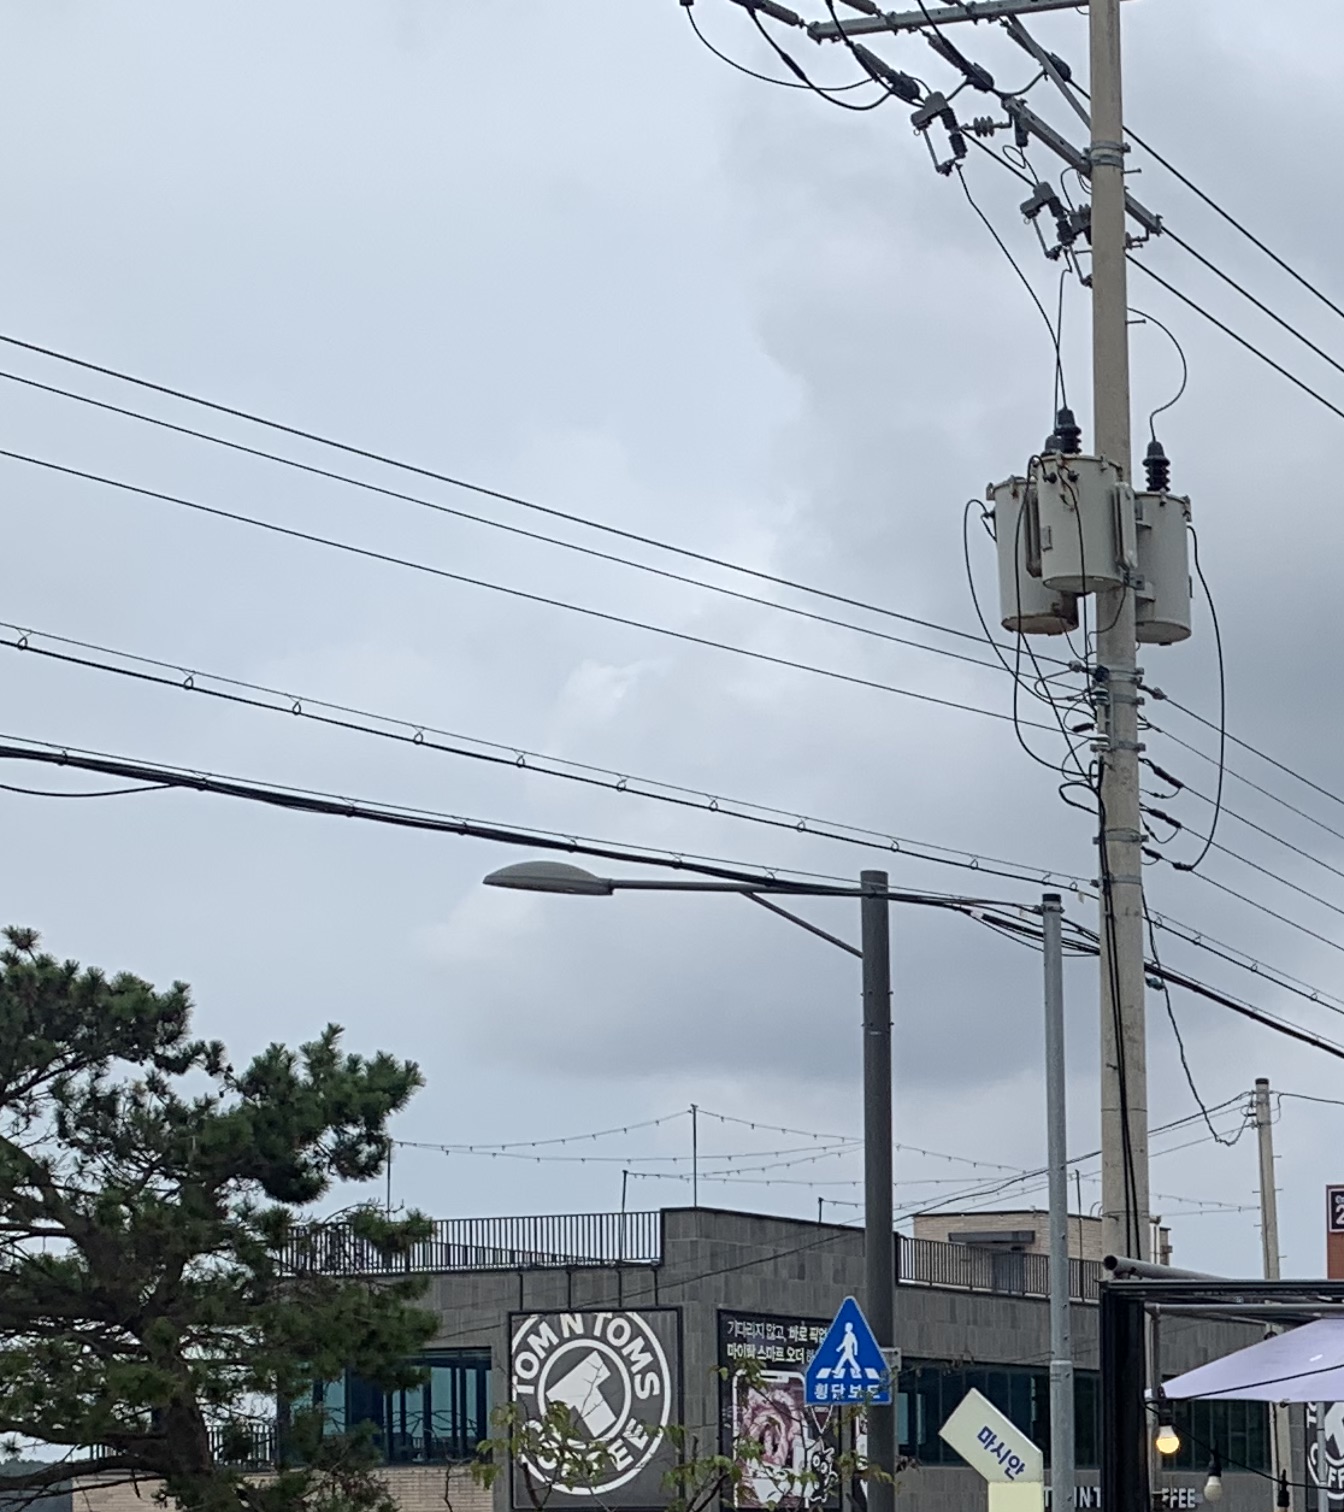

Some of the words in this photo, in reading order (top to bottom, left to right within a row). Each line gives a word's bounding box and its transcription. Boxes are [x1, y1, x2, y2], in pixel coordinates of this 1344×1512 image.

[727, 1319, 765, 1339] 기다리지
[513, 1322, 559, 1400] TOM
[560, 1313, 584, 1338] N
[593, 1313, 660, 1400] TOMS
[757, 1345, 785, 1362] 스마트
[786, 1346, 805, 1364] 오더
[814, 1382, 881, 1400] 횡단보도
[976, 1426, 1025, 1480] 마시안
